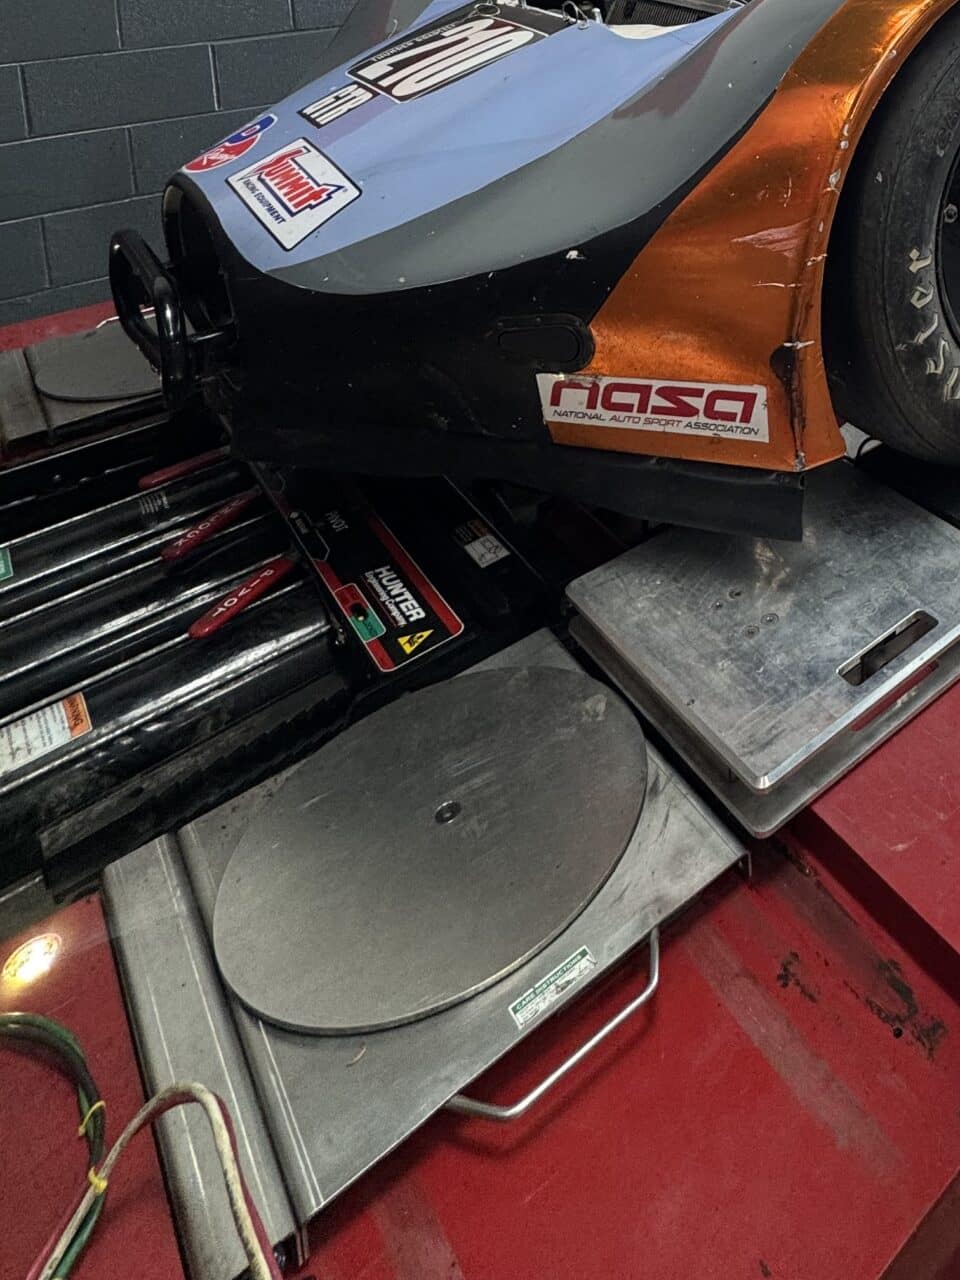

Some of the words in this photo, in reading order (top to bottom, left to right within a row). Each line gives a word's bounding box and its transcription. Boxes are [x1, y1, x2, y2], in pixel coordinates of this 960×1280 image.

[553, 409, 607, 422] NATIONAL
[609, 415, 641, 424] AUTO
[643, 417, 683, 427] SPORT
[684, 421, 760, 436] ASSOCIATION
[212, 569, 274, 617] PIVOT
[374, 565, 426, 622] HUNTER
[516, 992, 536, 1011] CARE
[534, 953, 582, 995] INSTRUCTIONS
